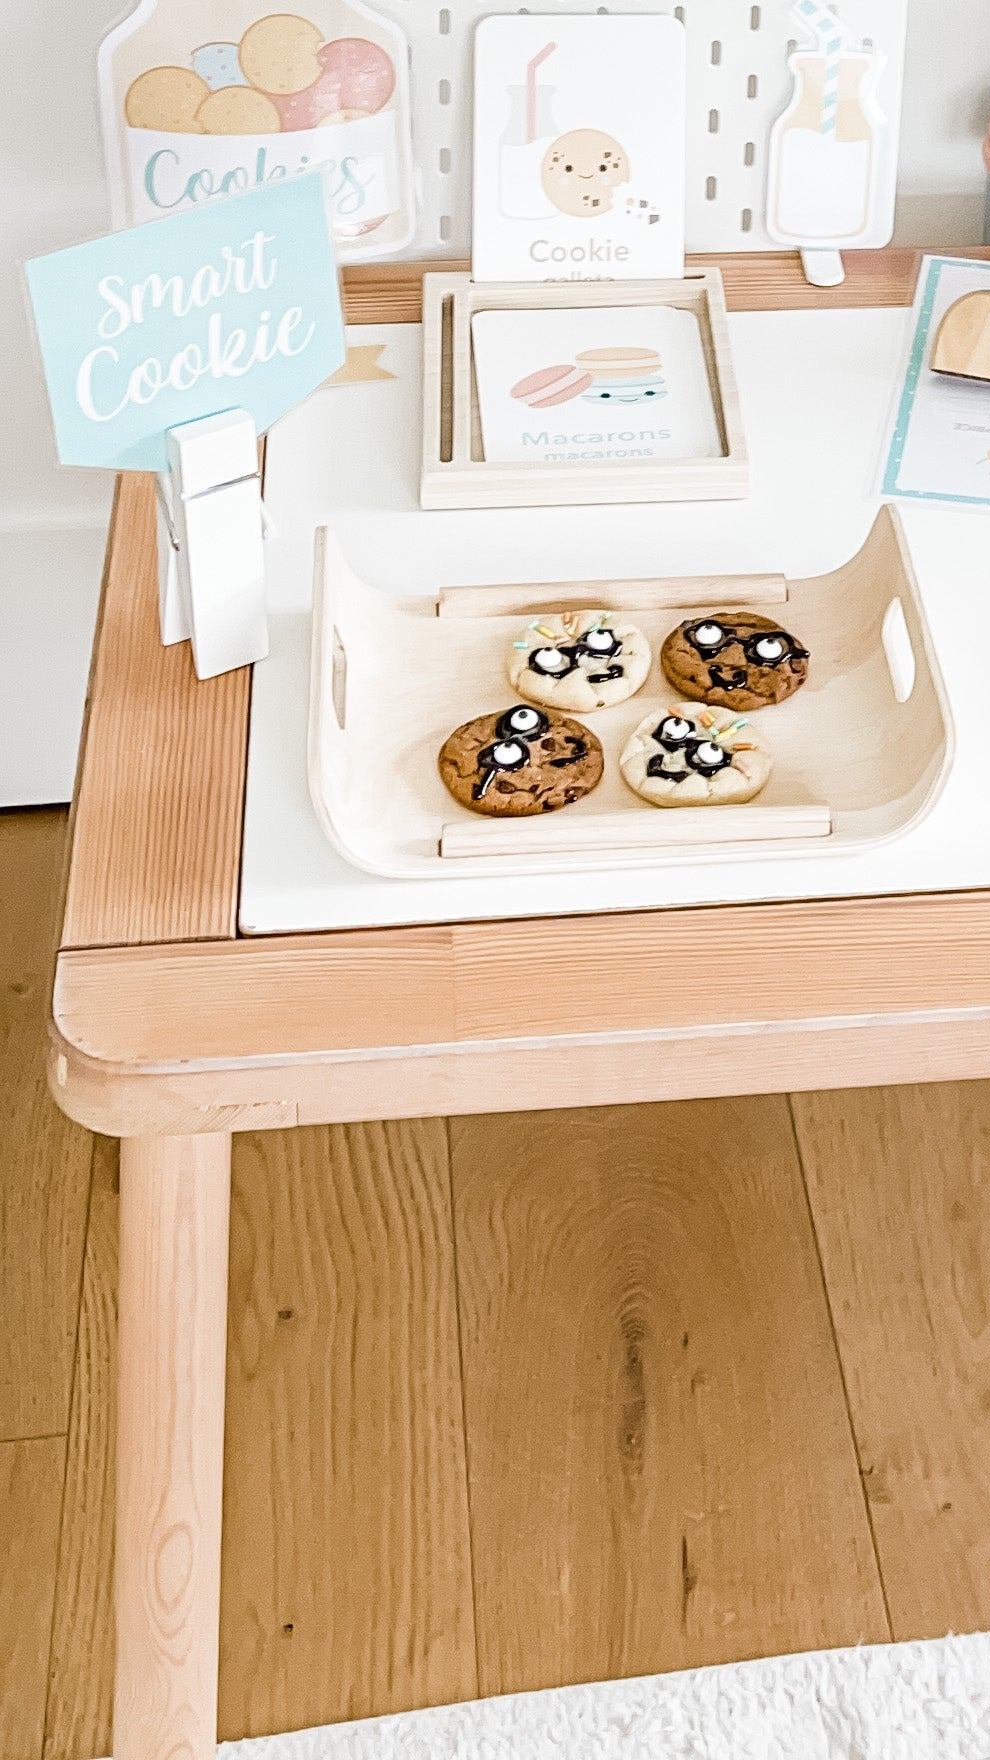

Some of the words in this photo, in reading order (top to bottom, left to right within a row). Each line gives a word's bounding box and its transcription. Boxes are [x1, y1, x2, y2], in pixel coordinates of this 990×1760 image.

[529, 238, 630, 262] Cookie
[77, 306, 316, 421] Cookie
[521, 428, 672, 446] Macarons
[544, 447, 654, 461] macarons
